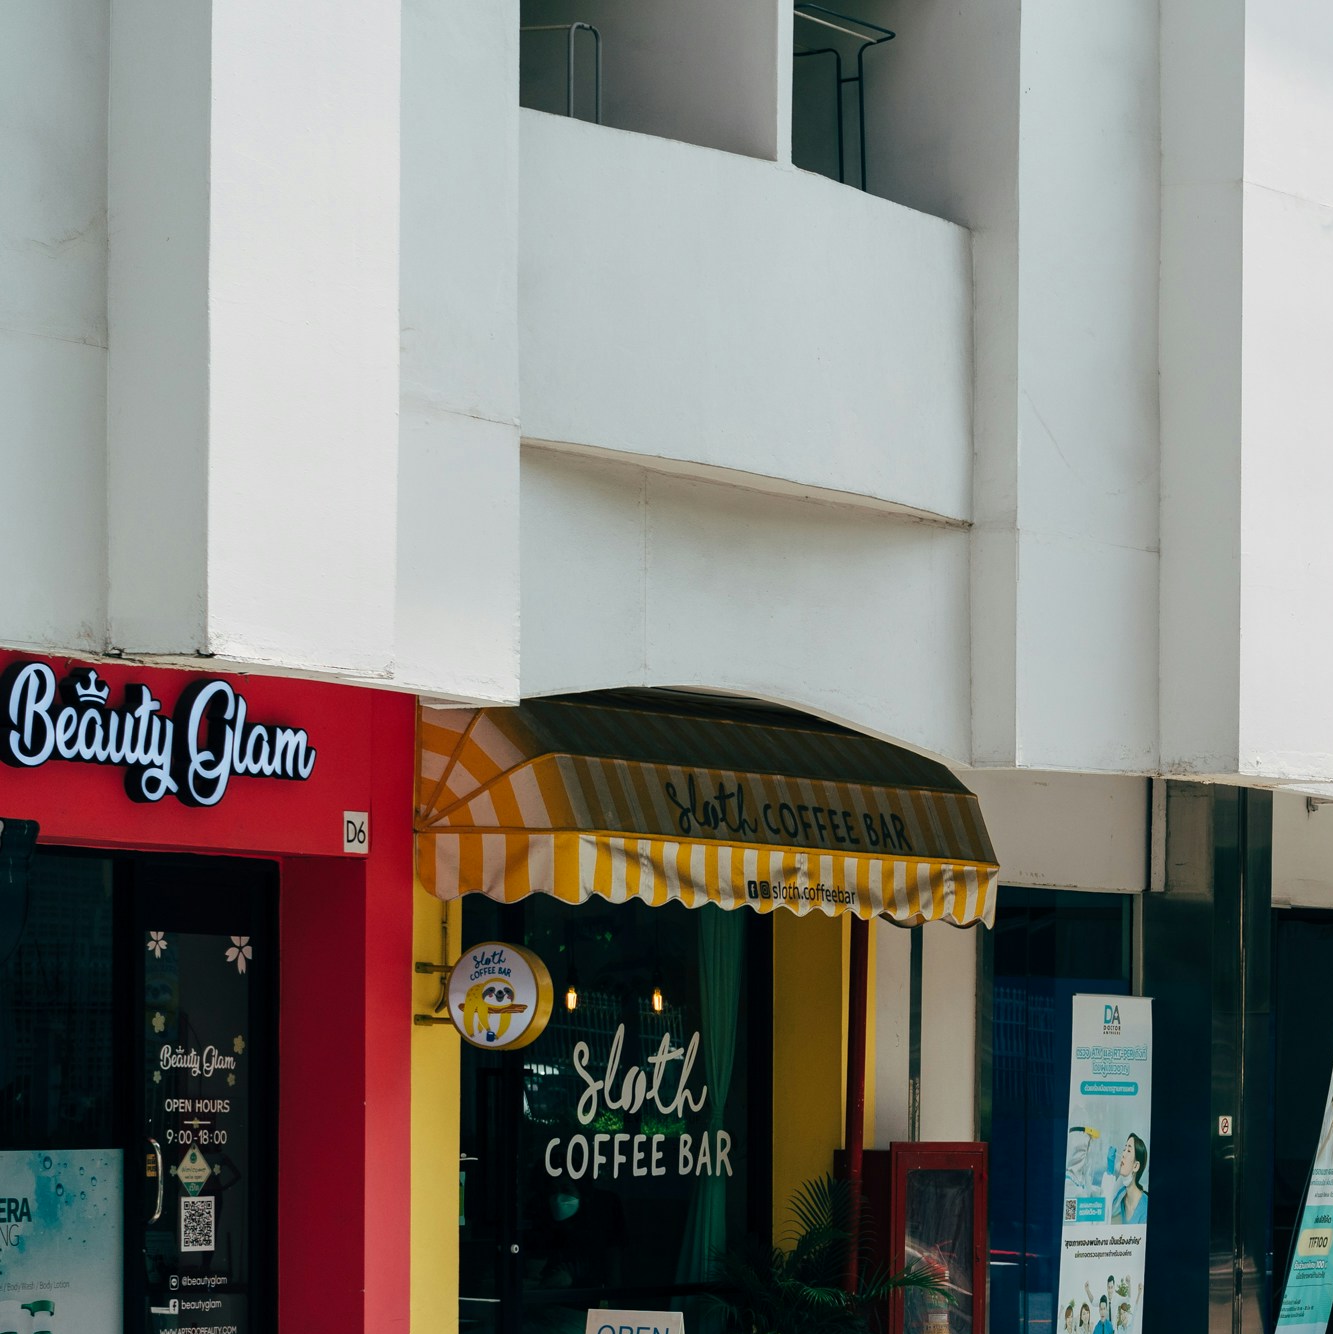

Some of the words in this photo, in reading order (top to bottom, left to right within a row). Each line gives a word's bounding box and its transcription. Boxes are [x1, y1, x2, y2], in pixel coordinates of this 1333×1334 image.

[8, 662, 178, 800] Beauty
[188, 680, 316, 805] Glam
[665, 773, 758, 836] Sloth
[763, 802, 860, 846] COFFEE
[863, 812, 913, 851] BAR
[346, 820, 366, 846] D6
[772, 880, 856, 905] sloth.coffeebar
[473, 949, 506, 969] Sloth
[469, 966, 496, 981] COFFEE
[498, 967, 512, 977] BAR
[1103, 1004, 1121, 1024] DA
[160, 1044, 201, 1077] Beauty
[203, 1045, 236, 1077] Glam
[572, 1023, 708, 1126] Sloth
[164, 1098, 192, 1112] OPEN
[195, 1099, 231, 1113] HOURS
[544, 1132, 666, 1180] COFFEE
[679, 1130, 734, 1179] BAR
[0, 1197, 32, 1223] ERA
[0, 1223, 20, 1247] NG
[181, 1274, 228, 1288] @beautyglam
[181, 1299, 222, 1312] beautyglam
